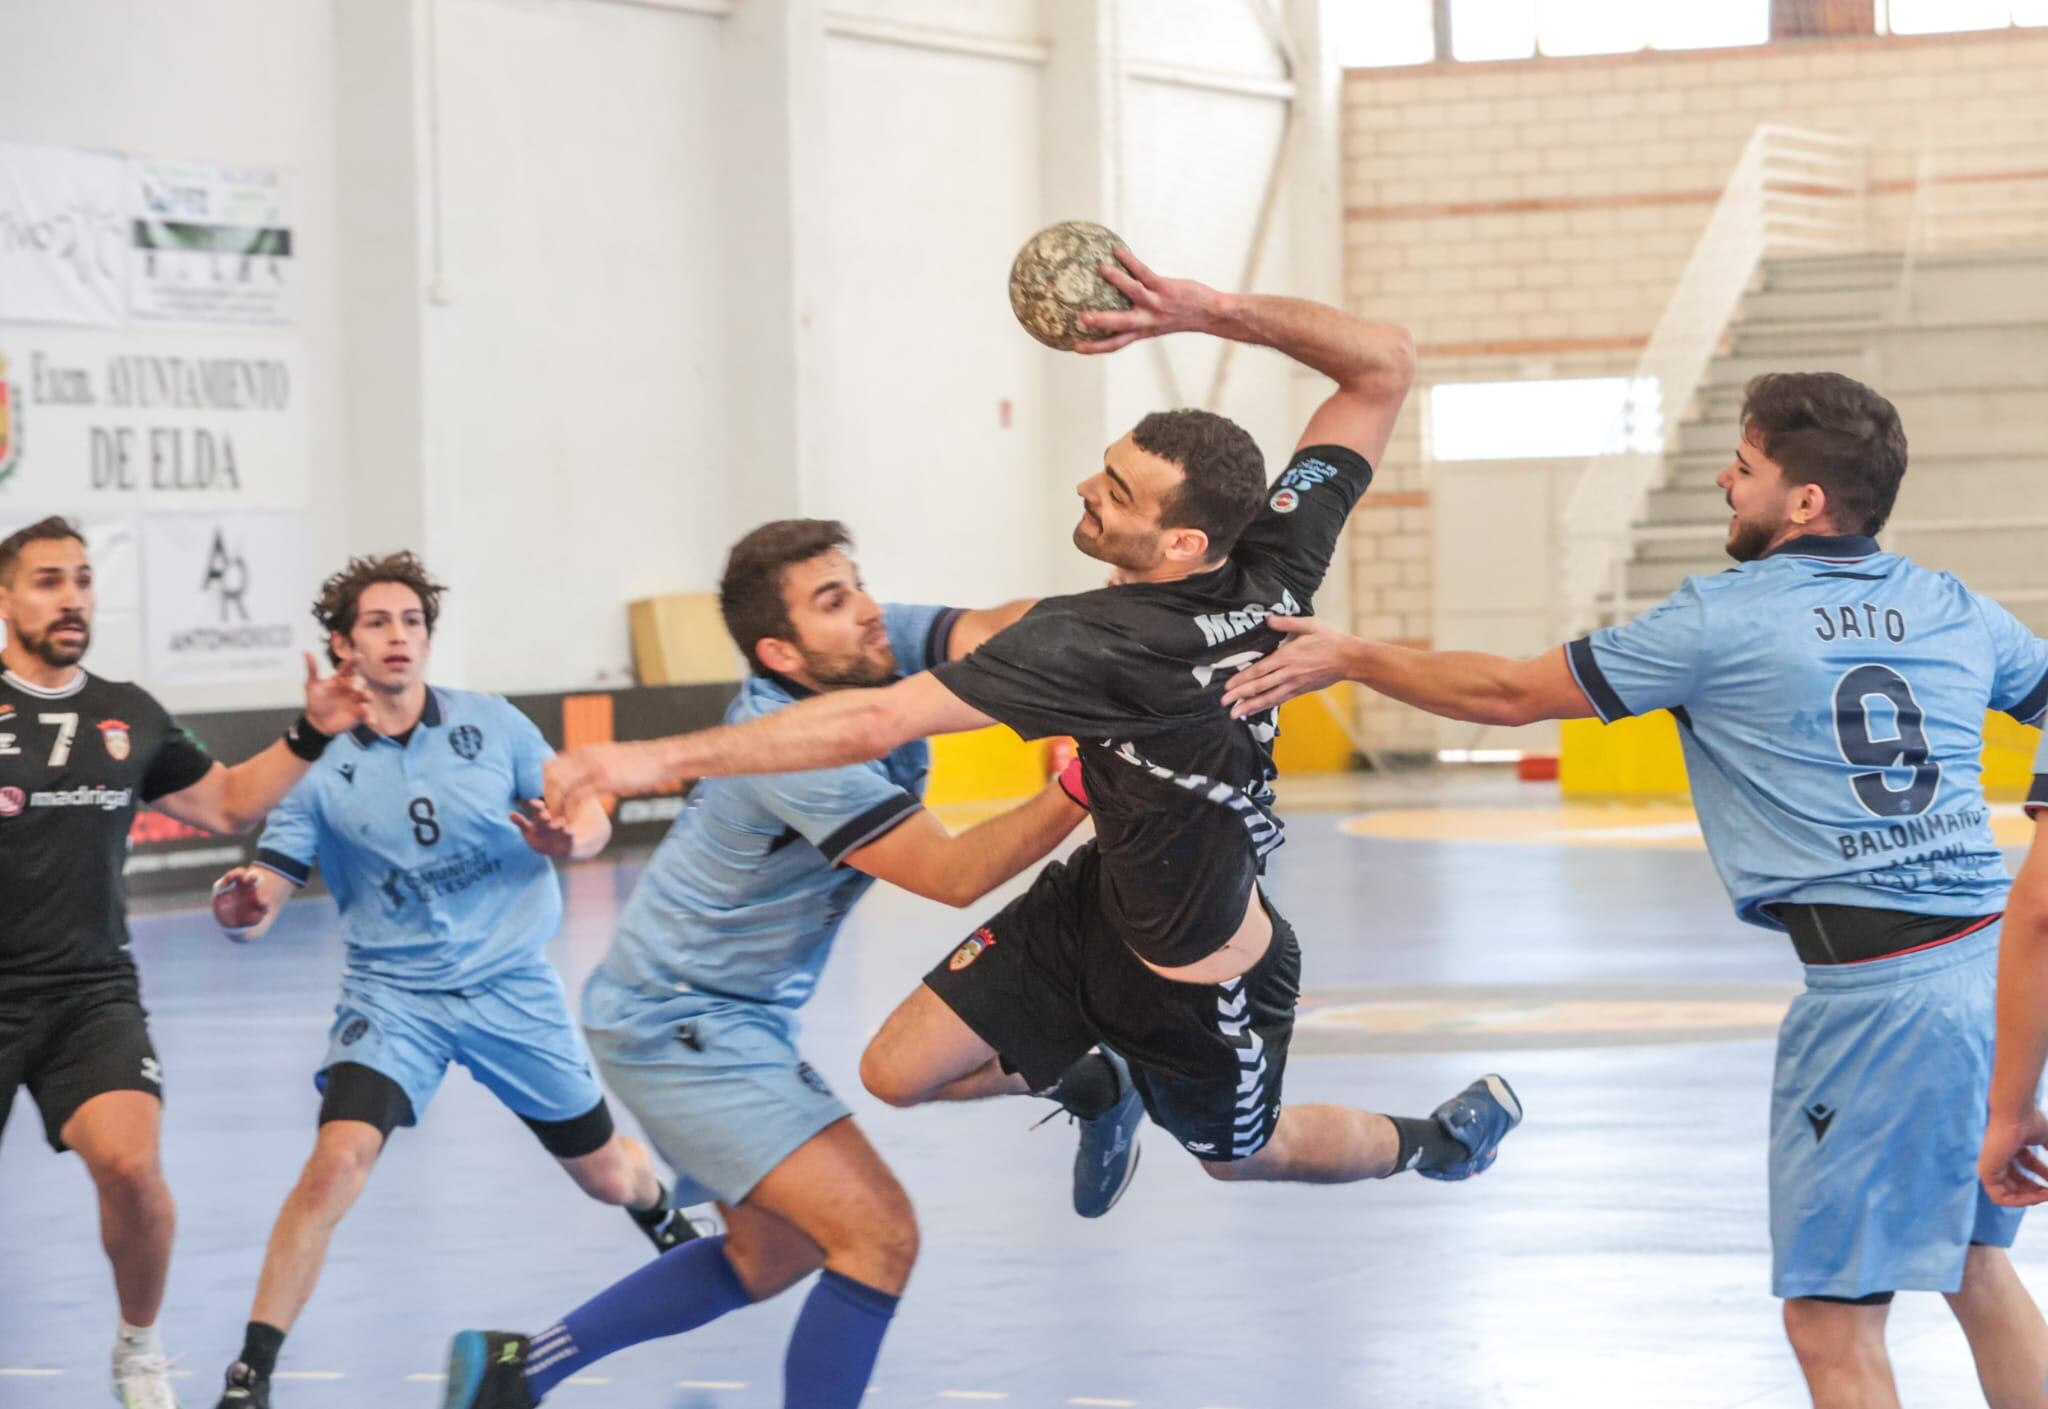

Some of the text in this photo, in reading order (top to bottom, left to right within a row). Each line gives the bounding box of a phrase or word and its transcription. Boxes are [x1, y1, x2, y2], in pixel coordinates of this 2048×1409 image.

[106, 355, 290, 411] AYUNTAMIENTO
[90, 427, 242, 491] DE ELDA
[1813, 603, 1906, 643] JATO
[38, 712, 79, 767] 7
[1832, 663, 1943, 818] 9
[408, 796, 441, 847] 8
